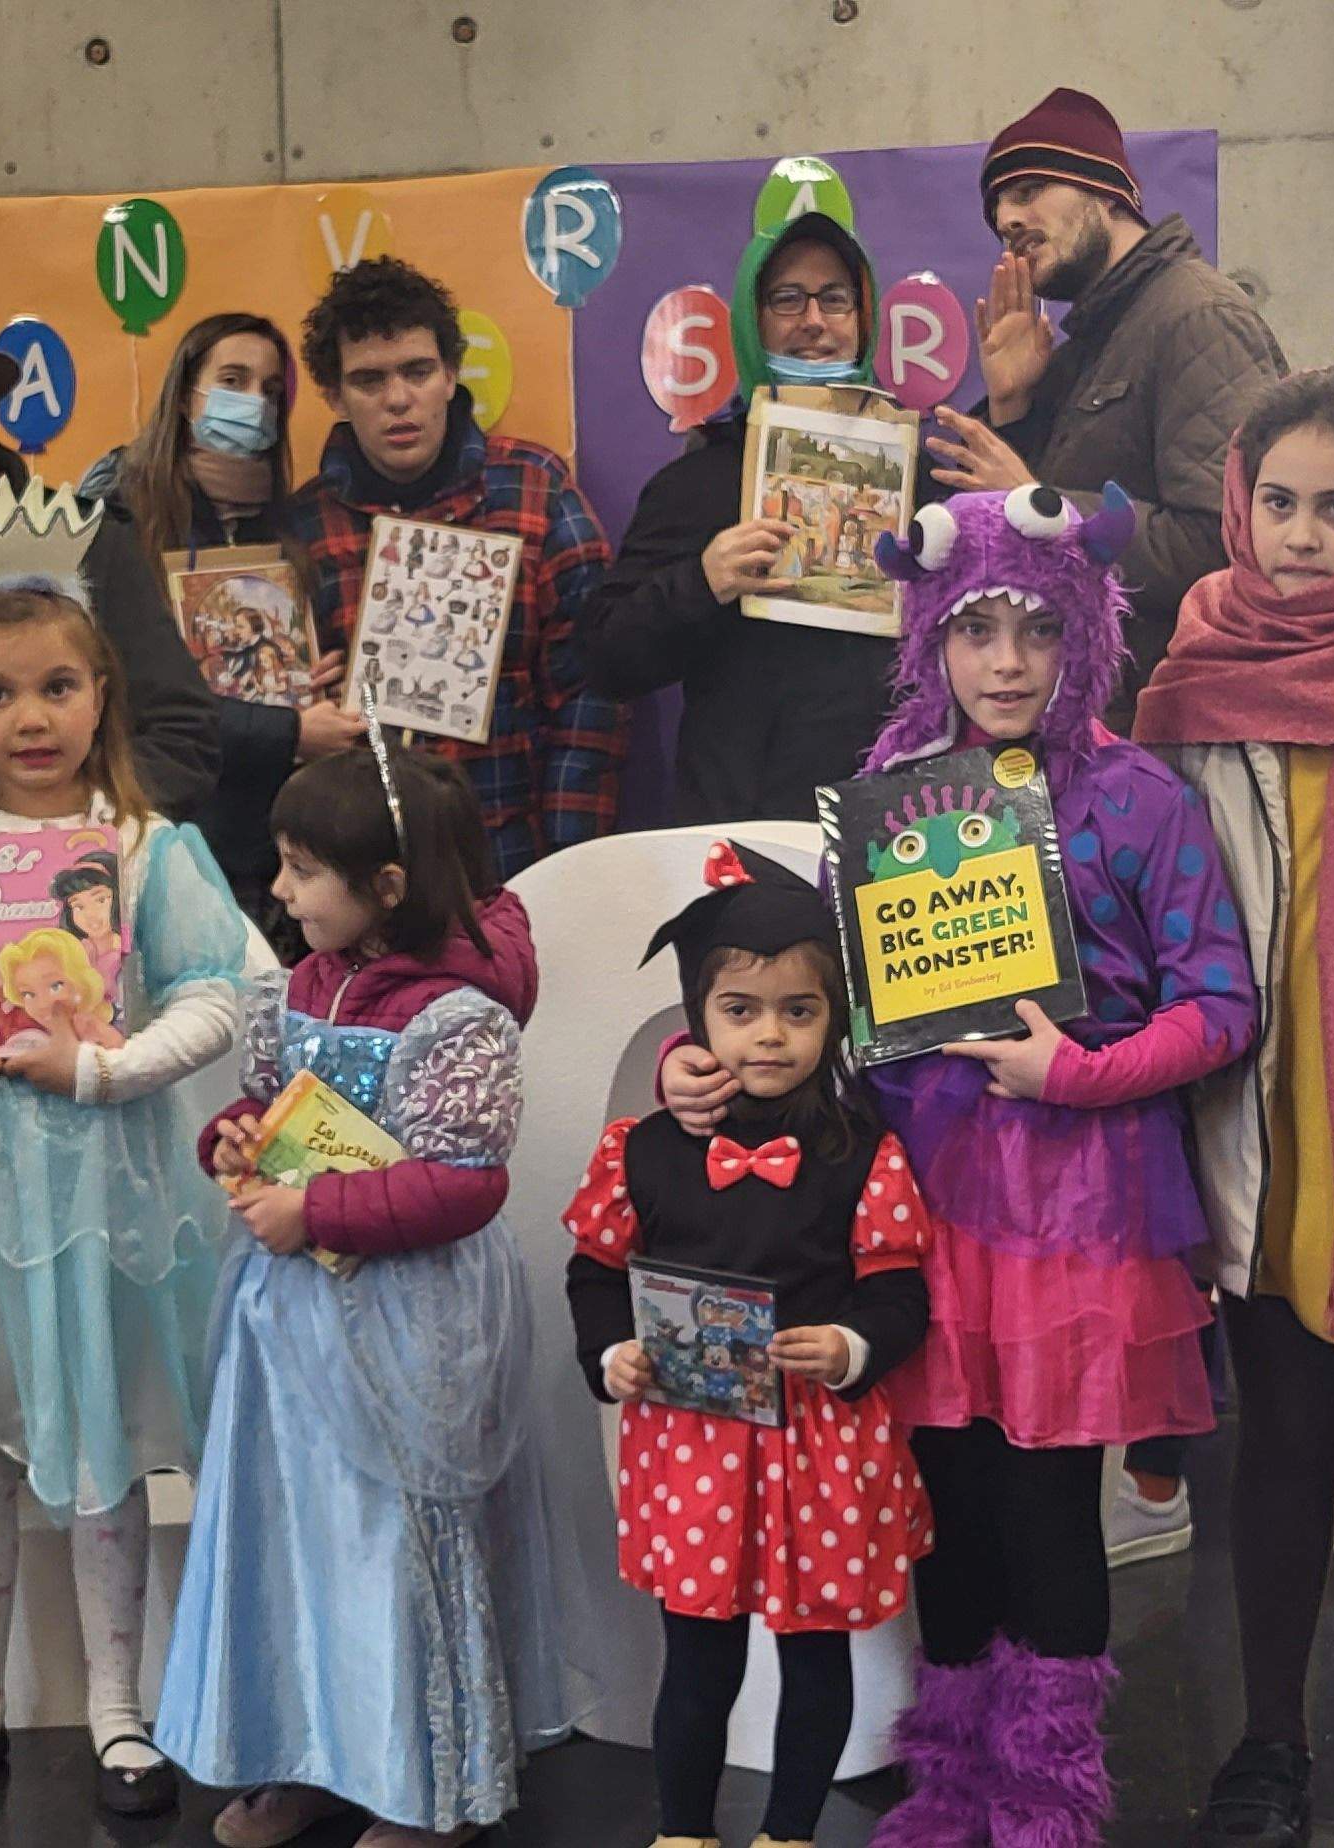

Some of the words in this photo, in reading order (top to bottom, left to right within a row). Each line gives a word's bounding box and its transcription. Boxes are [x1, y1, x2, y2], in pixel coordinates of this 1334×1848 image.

[875, 897, 917, 924] GO
[927, 872, 1025, 915] AWAY,
[879, 927, 925, 955] BIG
[931, 901, 1029, 941] GREEN
[884, 929, 1036, 984] MONSTER!
[938, 979, 952, 993] Ed
